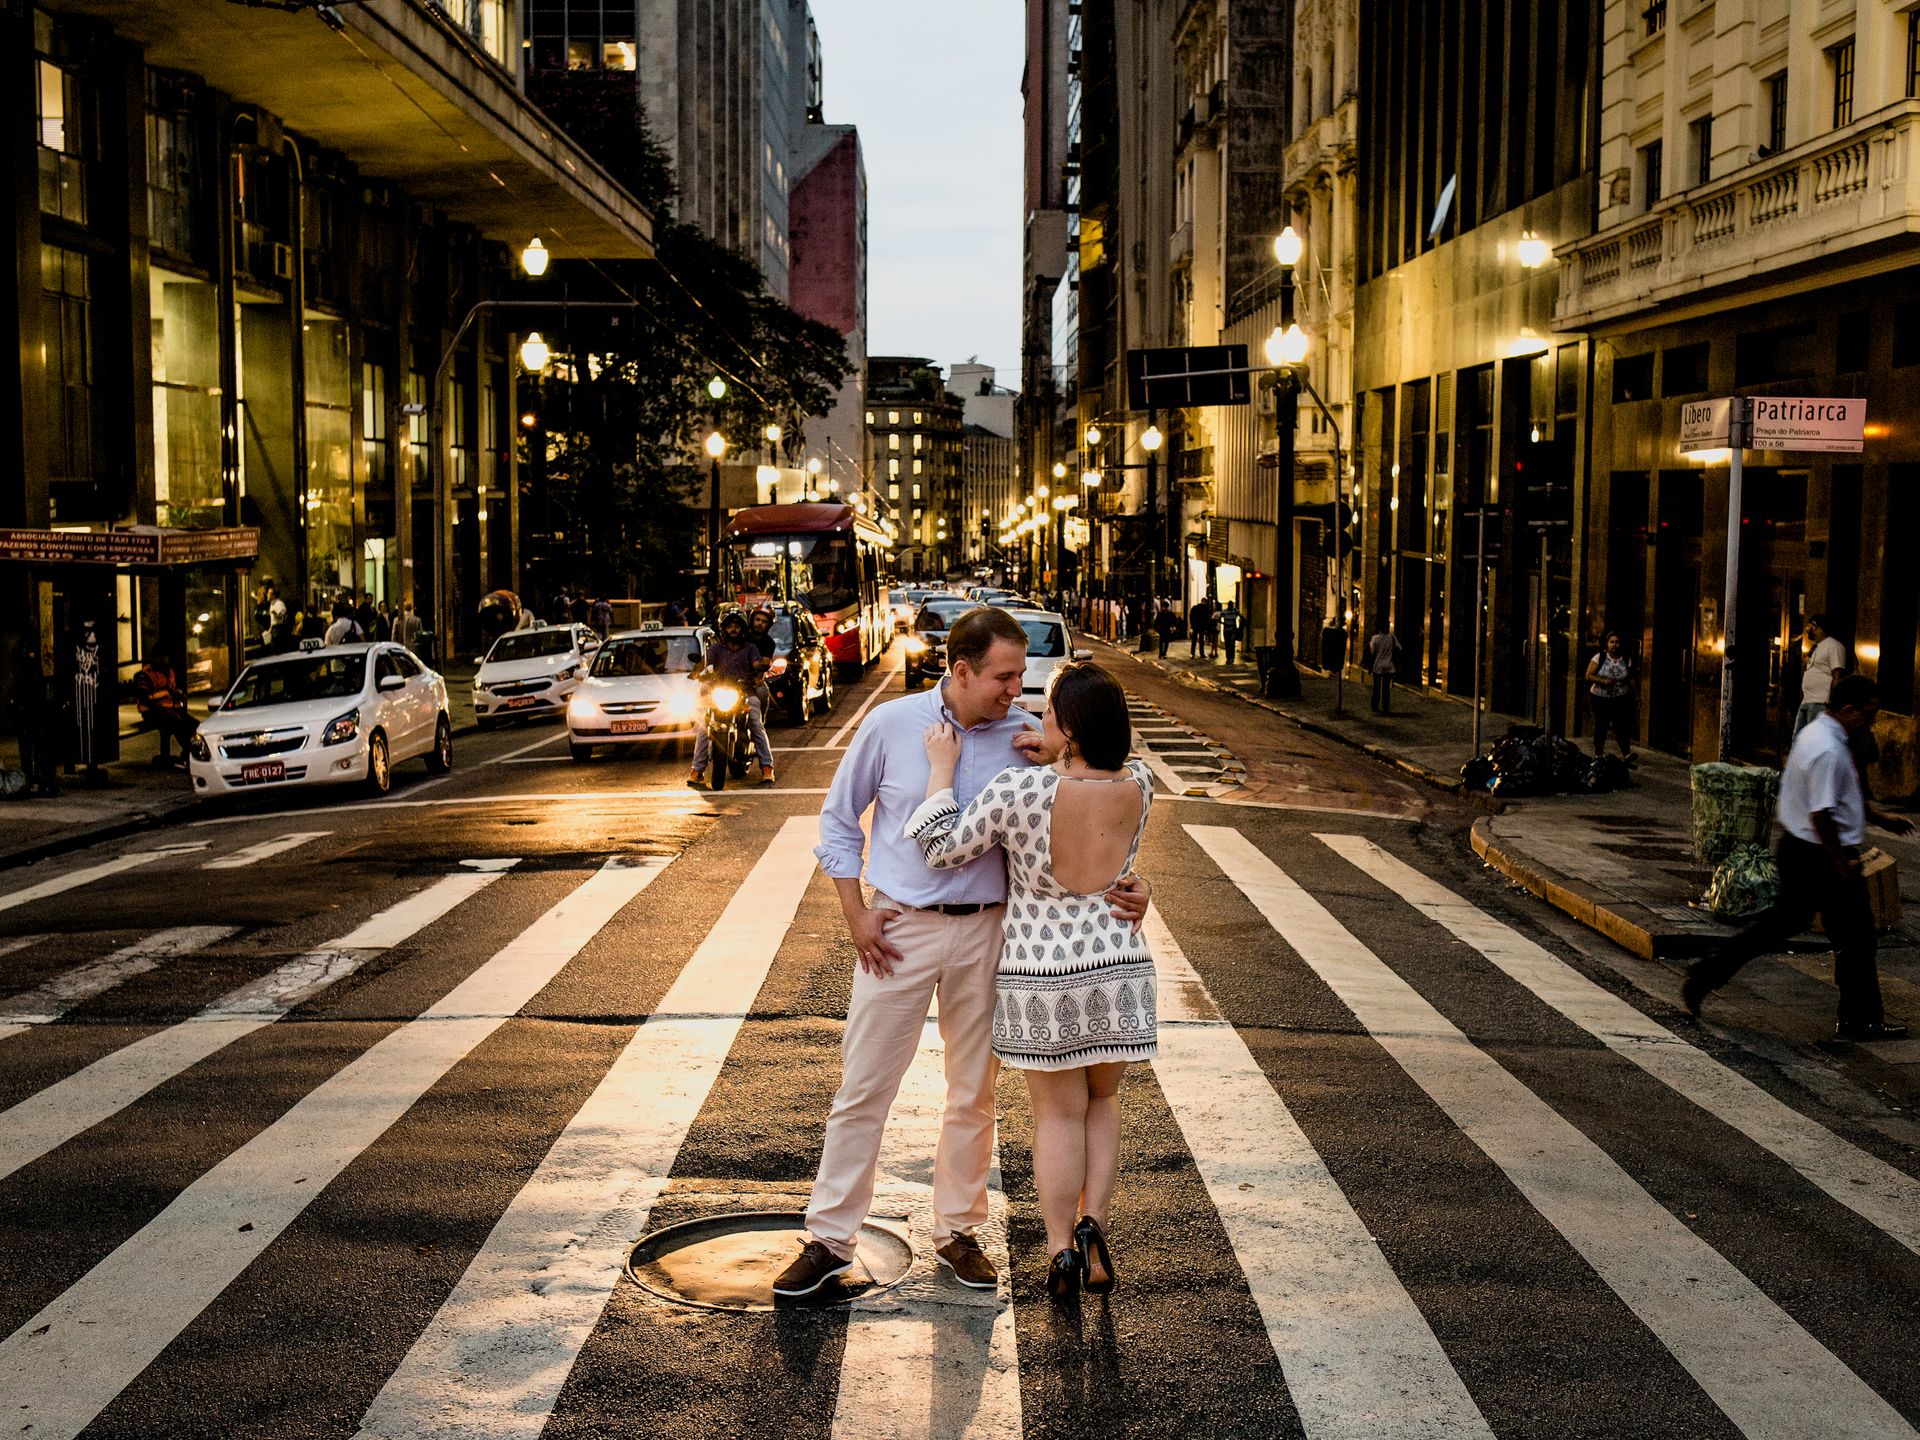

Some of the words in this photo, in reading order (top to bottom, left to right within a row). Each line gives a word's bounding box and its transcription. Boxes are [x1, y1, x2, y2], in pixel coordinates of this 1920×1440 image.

[1757, 400, 1846, 421] Patriarca
[1756, 427, 1776, 436] Praça
[1778, 427, 1787, 435] do
[1789, 428, 1820, 436] Patriarca
[644, 622, 660, 630] TAXI
[302, 640, 320, 650] TAXI
